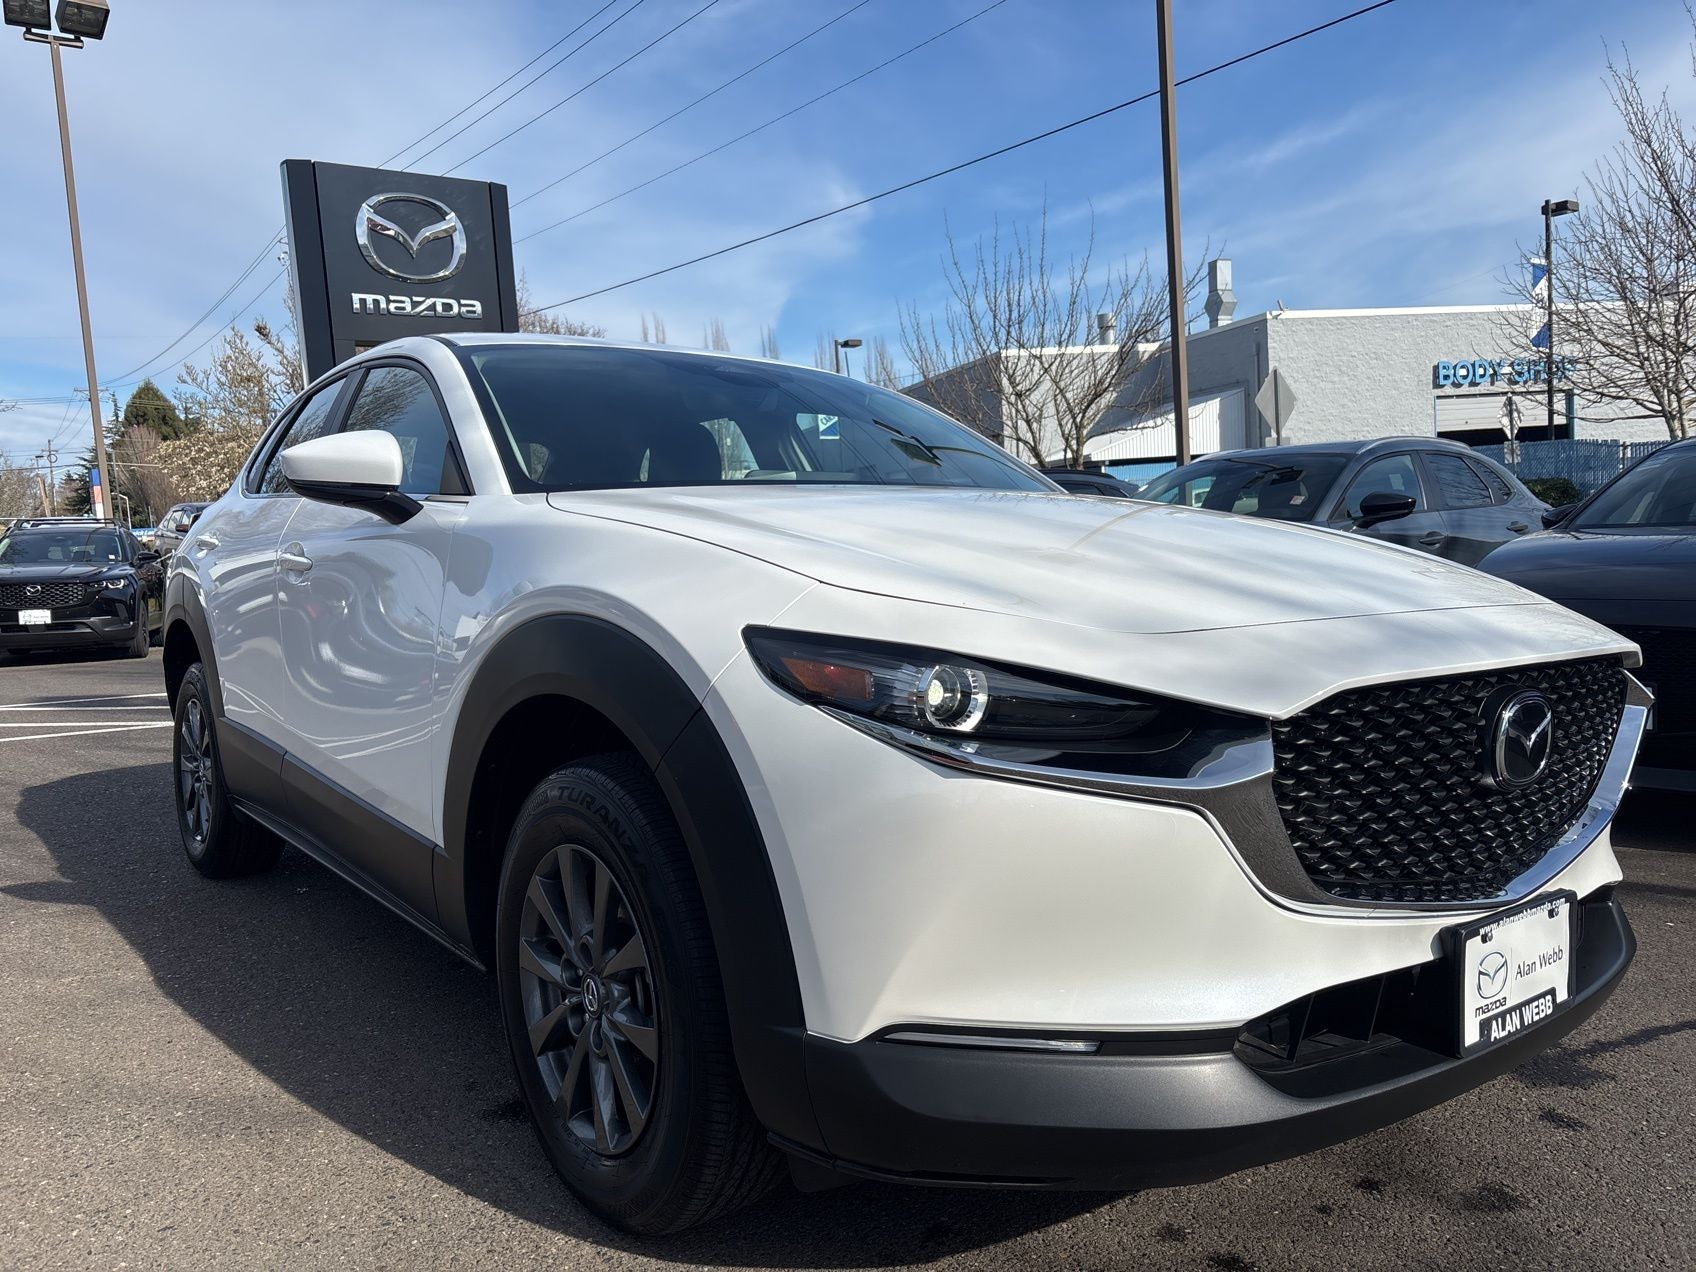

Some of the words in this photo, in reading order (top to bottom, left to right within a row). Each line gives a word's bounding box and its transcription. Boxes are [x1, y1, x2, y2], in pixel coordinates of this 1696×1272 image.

[1436, 358, 1506, 386] BODY
[1515, 959, 1537, 981] Alan
[1538, 944, 1564, 970] Webb
[1490, 1008, 1521, 1043] ALAN
[1521, 994, 1553, 1027] WEBB
